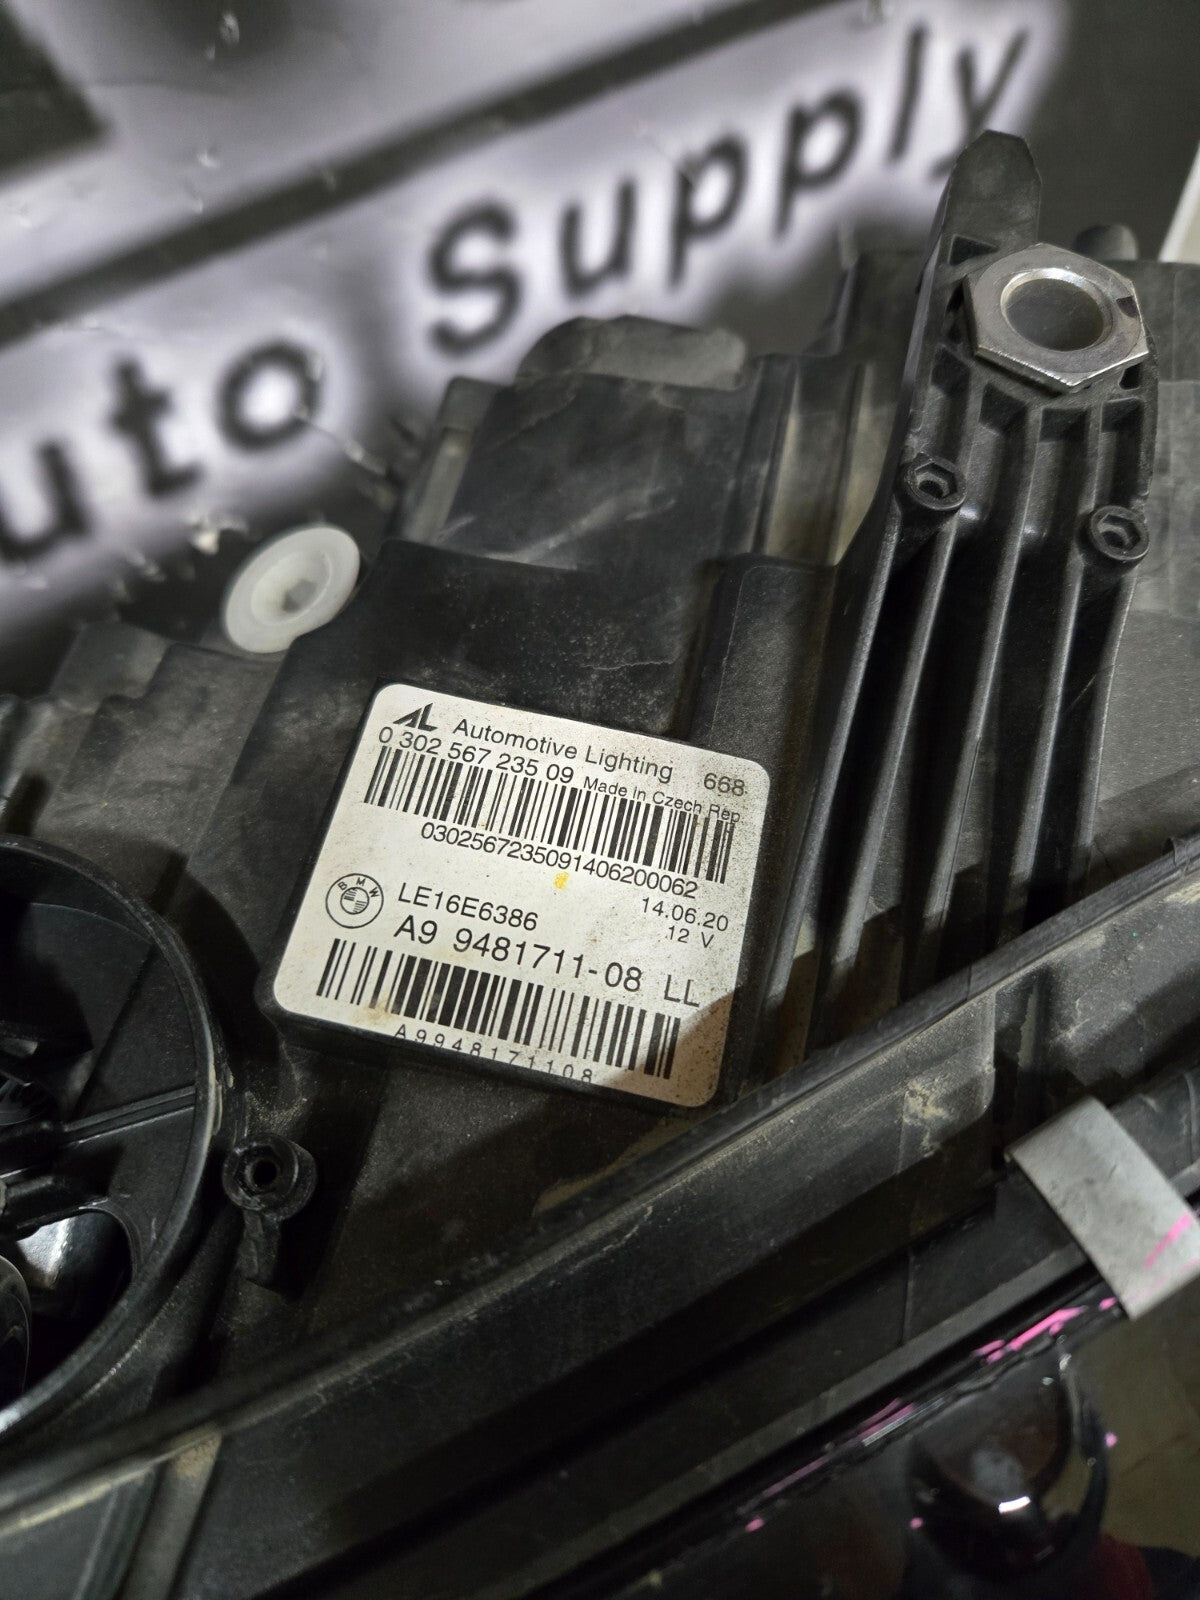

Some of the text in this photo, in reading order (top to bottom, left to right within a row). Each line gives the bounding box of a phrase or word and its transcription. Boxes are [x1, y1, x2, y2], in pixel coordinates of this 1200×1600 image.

[426, 23, 1030, 359] Supply
[378, 726, 575, 783] 0 302 567 235 09
[453, 718, 577, 760] Automotive
[585, 745, 673, 784] Lighting
[703, 772, 746, 797] 668
[583, 776, 628, 797] Made
[633, 786, 646, 801] in
[652, 791, 703, 813] Czech
[421, 821, 698, 899] 0302567235091406200062
[398, 882, 539, 931] LE16E6386
[642, 896, 729, 932] 14.06.20
[393, 914, 700, 1008] A9 9481711-08 LL
[668, 925, 715, 949] 12 V
